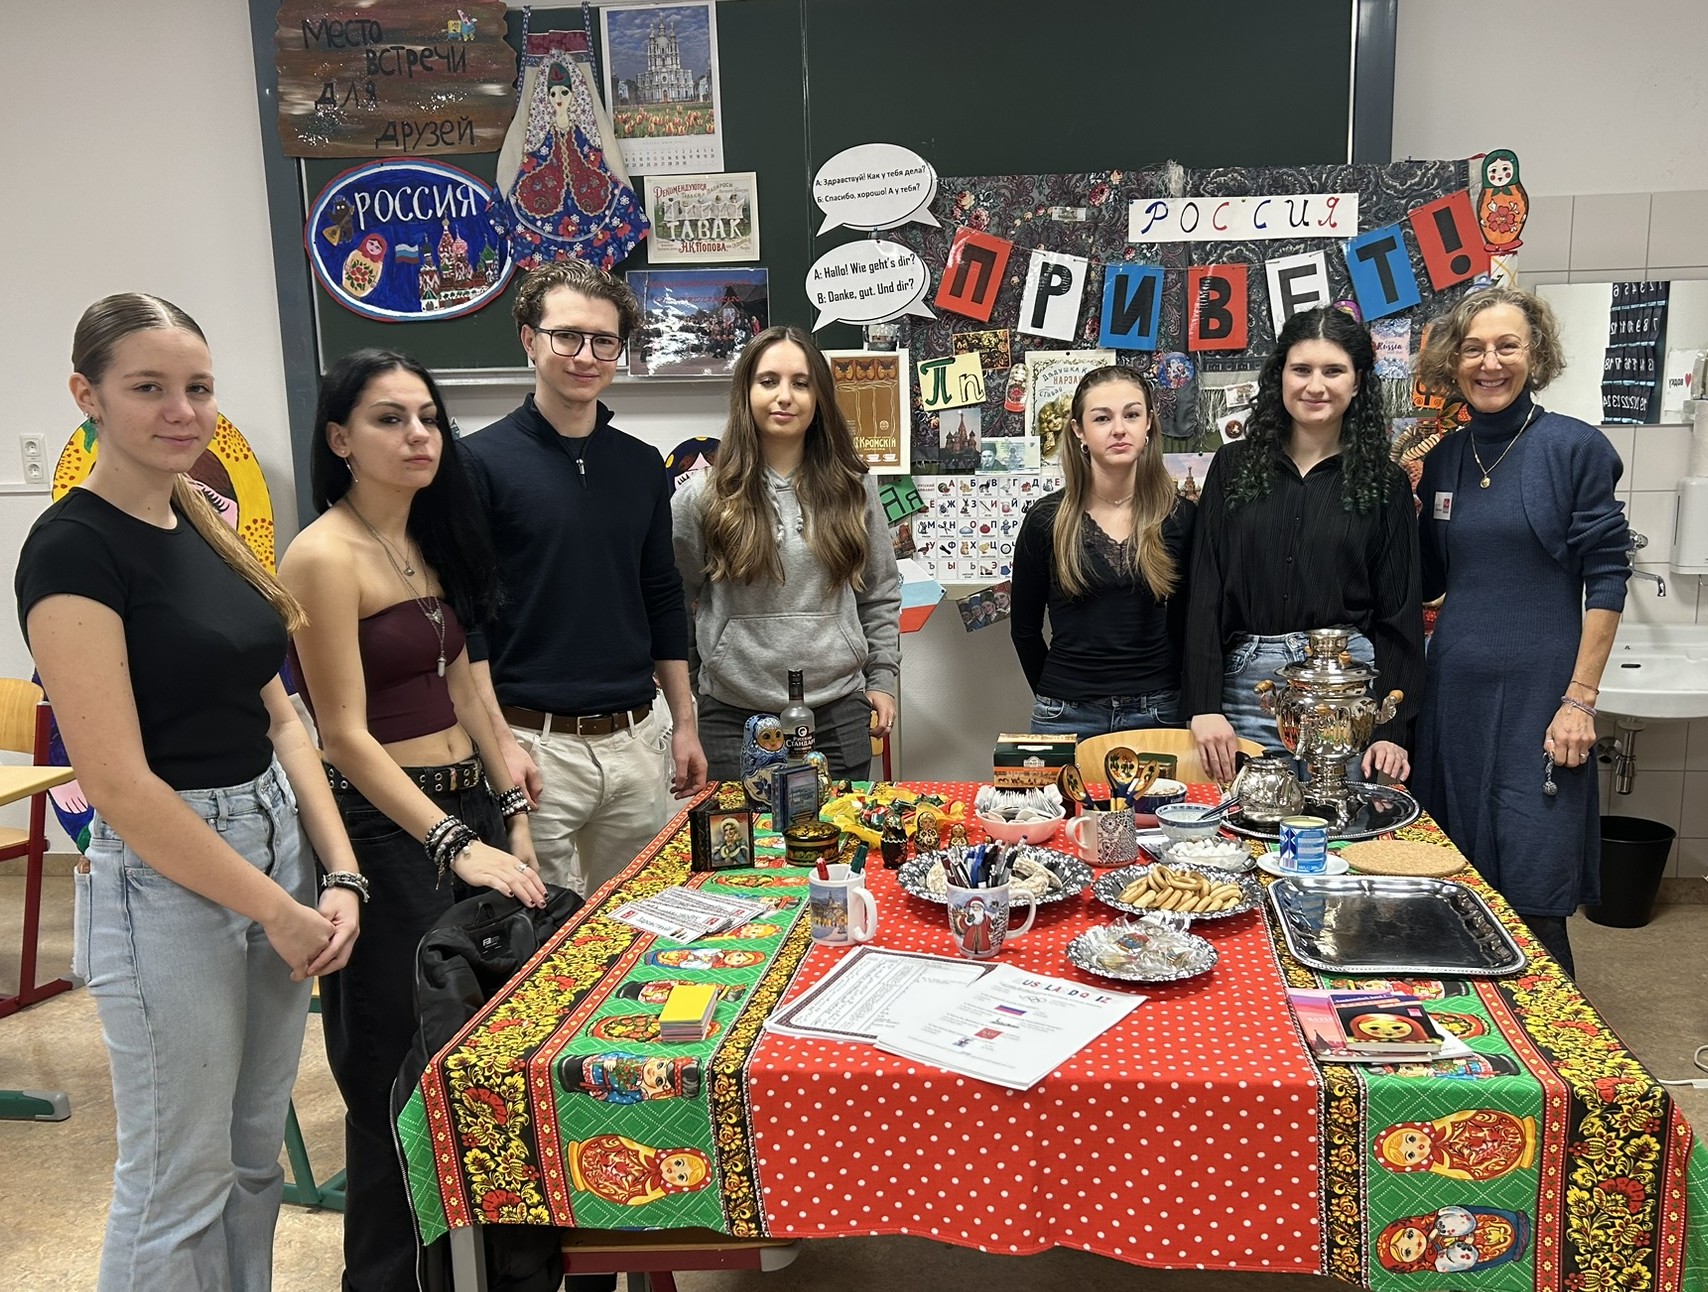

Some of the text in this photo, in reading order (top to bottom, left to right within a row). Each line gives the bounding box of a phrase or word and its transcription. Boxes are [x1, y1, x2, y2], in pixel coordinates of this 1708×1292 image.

[824, 172, 866, 186] Здравствуй!
[887, 168, 903, 177] тебя
[904, 165, 926, 176] дела?
[817, 196, 823, 204] Б:
[857, 187, 888, 198] хорошо!
[900, 183, 921, 193] тебя?
[354, 184, 477, 231] РОССИЯ
[1141, 196, 1341, 235] РОССИЯ
[814, 253, 916, 280] A: Hallo! Wie geht's dir?
[949, 206, 1472, 340] ПРИВЕТ!
[817, 278, 914, 305] B: Danke, gut. Und dir?
